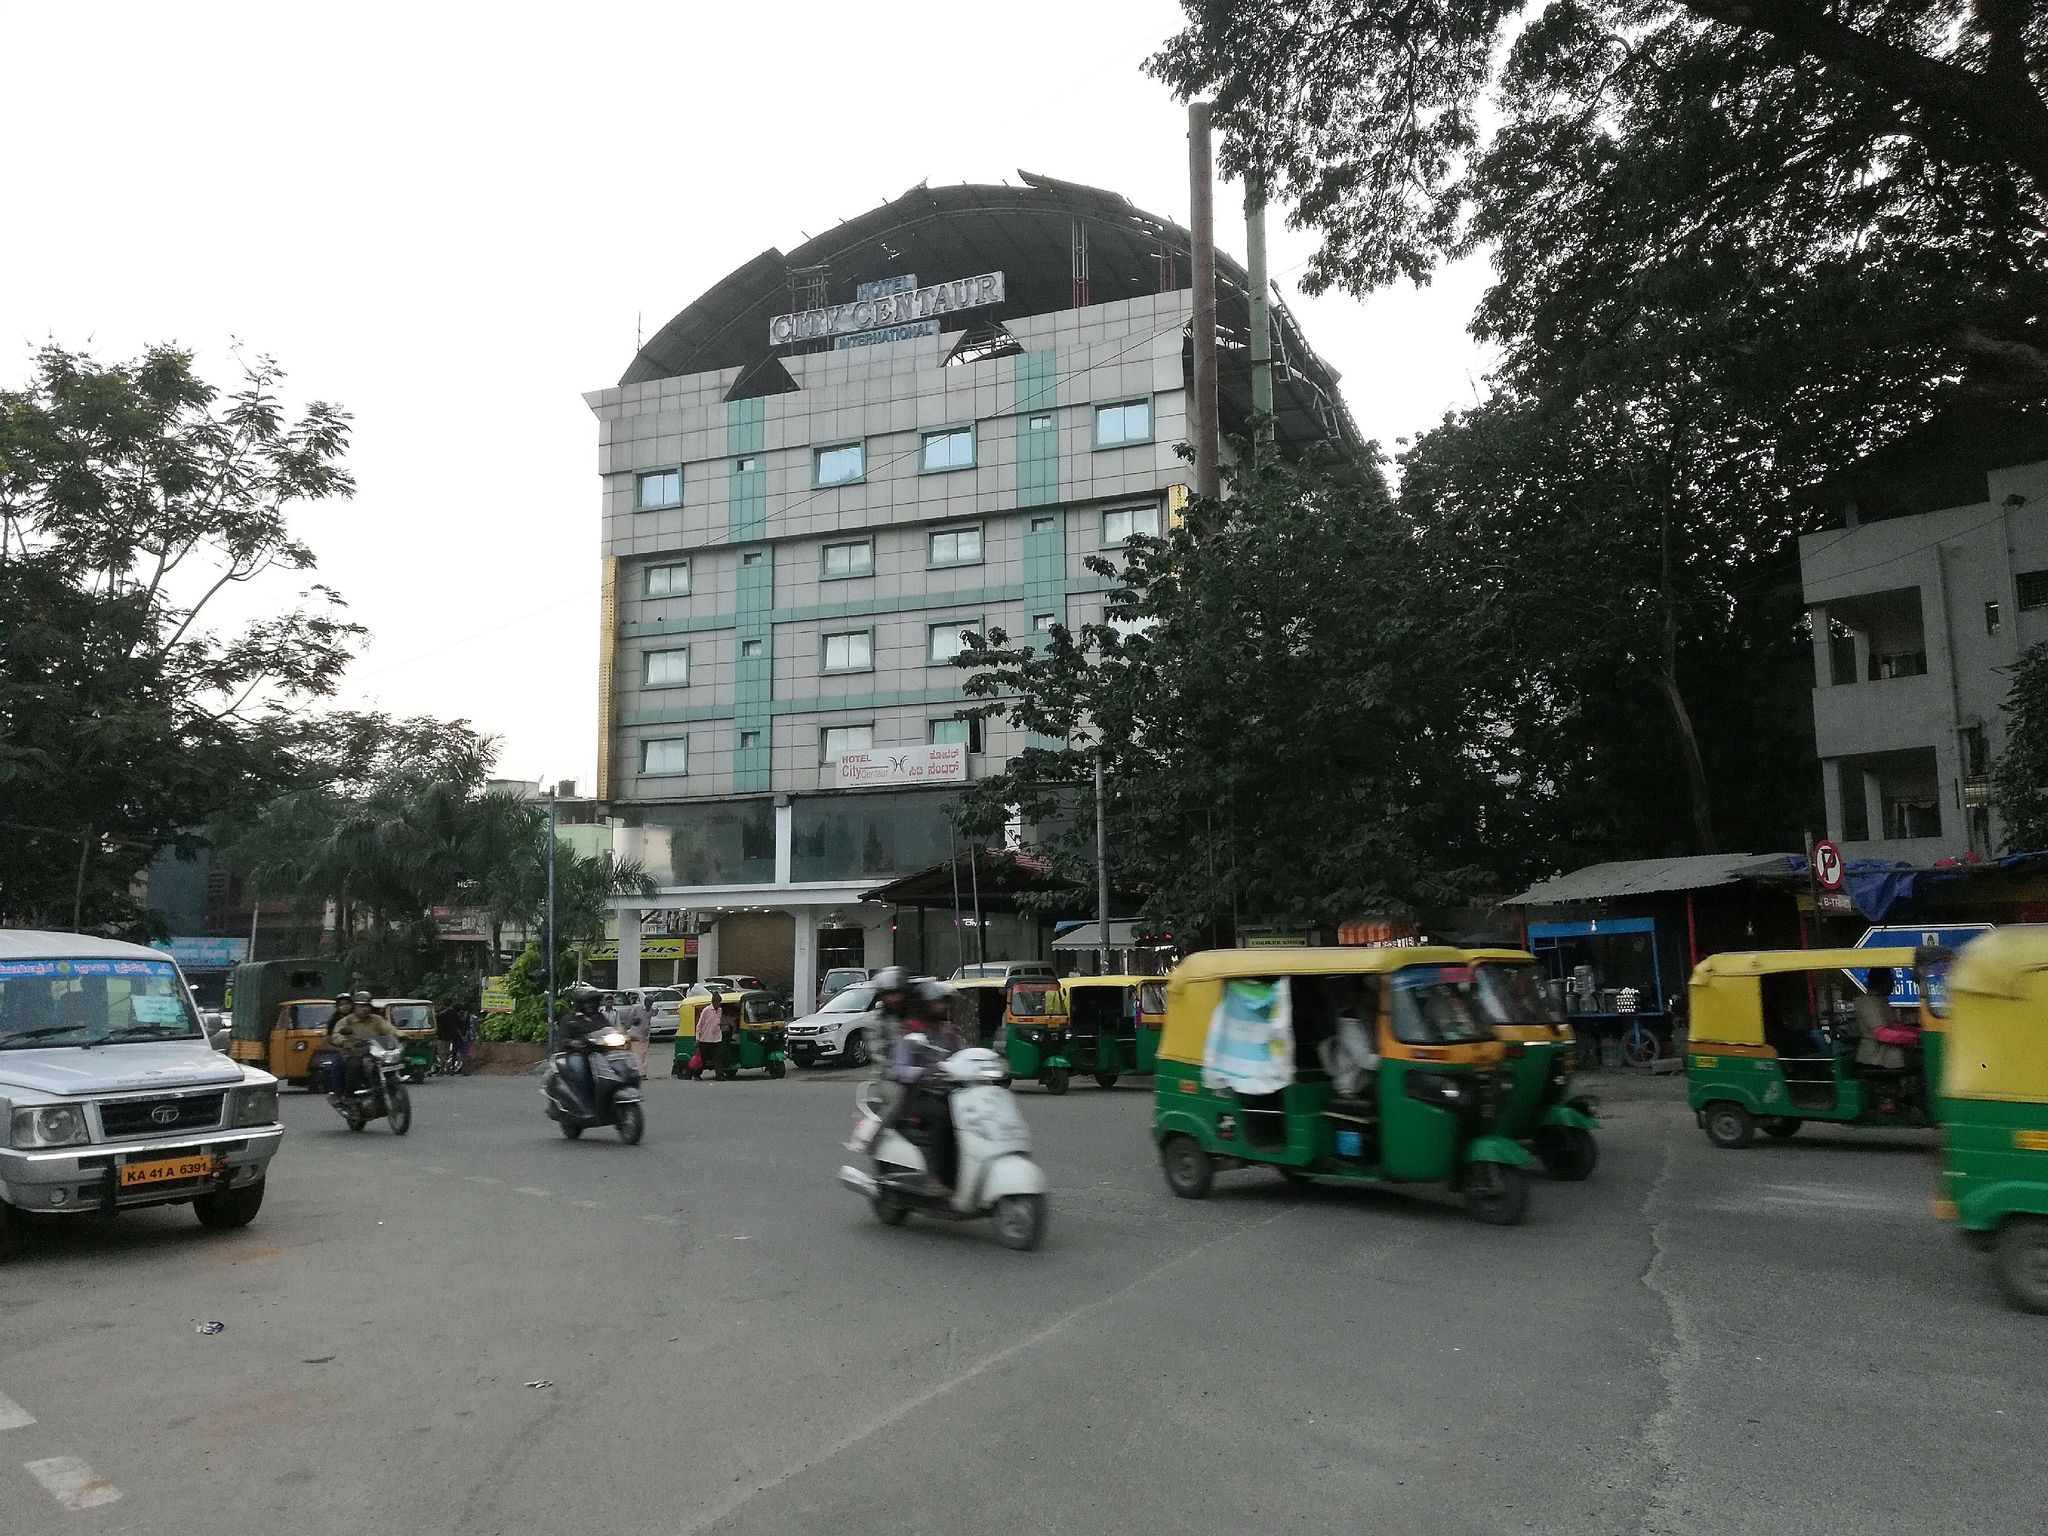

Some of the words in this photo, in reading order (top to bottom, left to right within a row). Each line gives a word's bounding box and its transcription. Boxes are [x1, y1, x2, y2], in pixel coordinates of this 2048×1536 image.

[859, 276, 912, 300] HOTEL
[773, 306, 844, 342] CITY
[853, 275, 998, 328] CENTAUR
[839, 324, 933, 348] INTERNATIONAL
[842, 754, 872, 763] HOTEL
[127, 1171, 145, 1181] KA
[150, 1168, 162, 1178] 41
[166, 1167, 174, 1176] A
[180, 1162, 207, 1175] 6391
